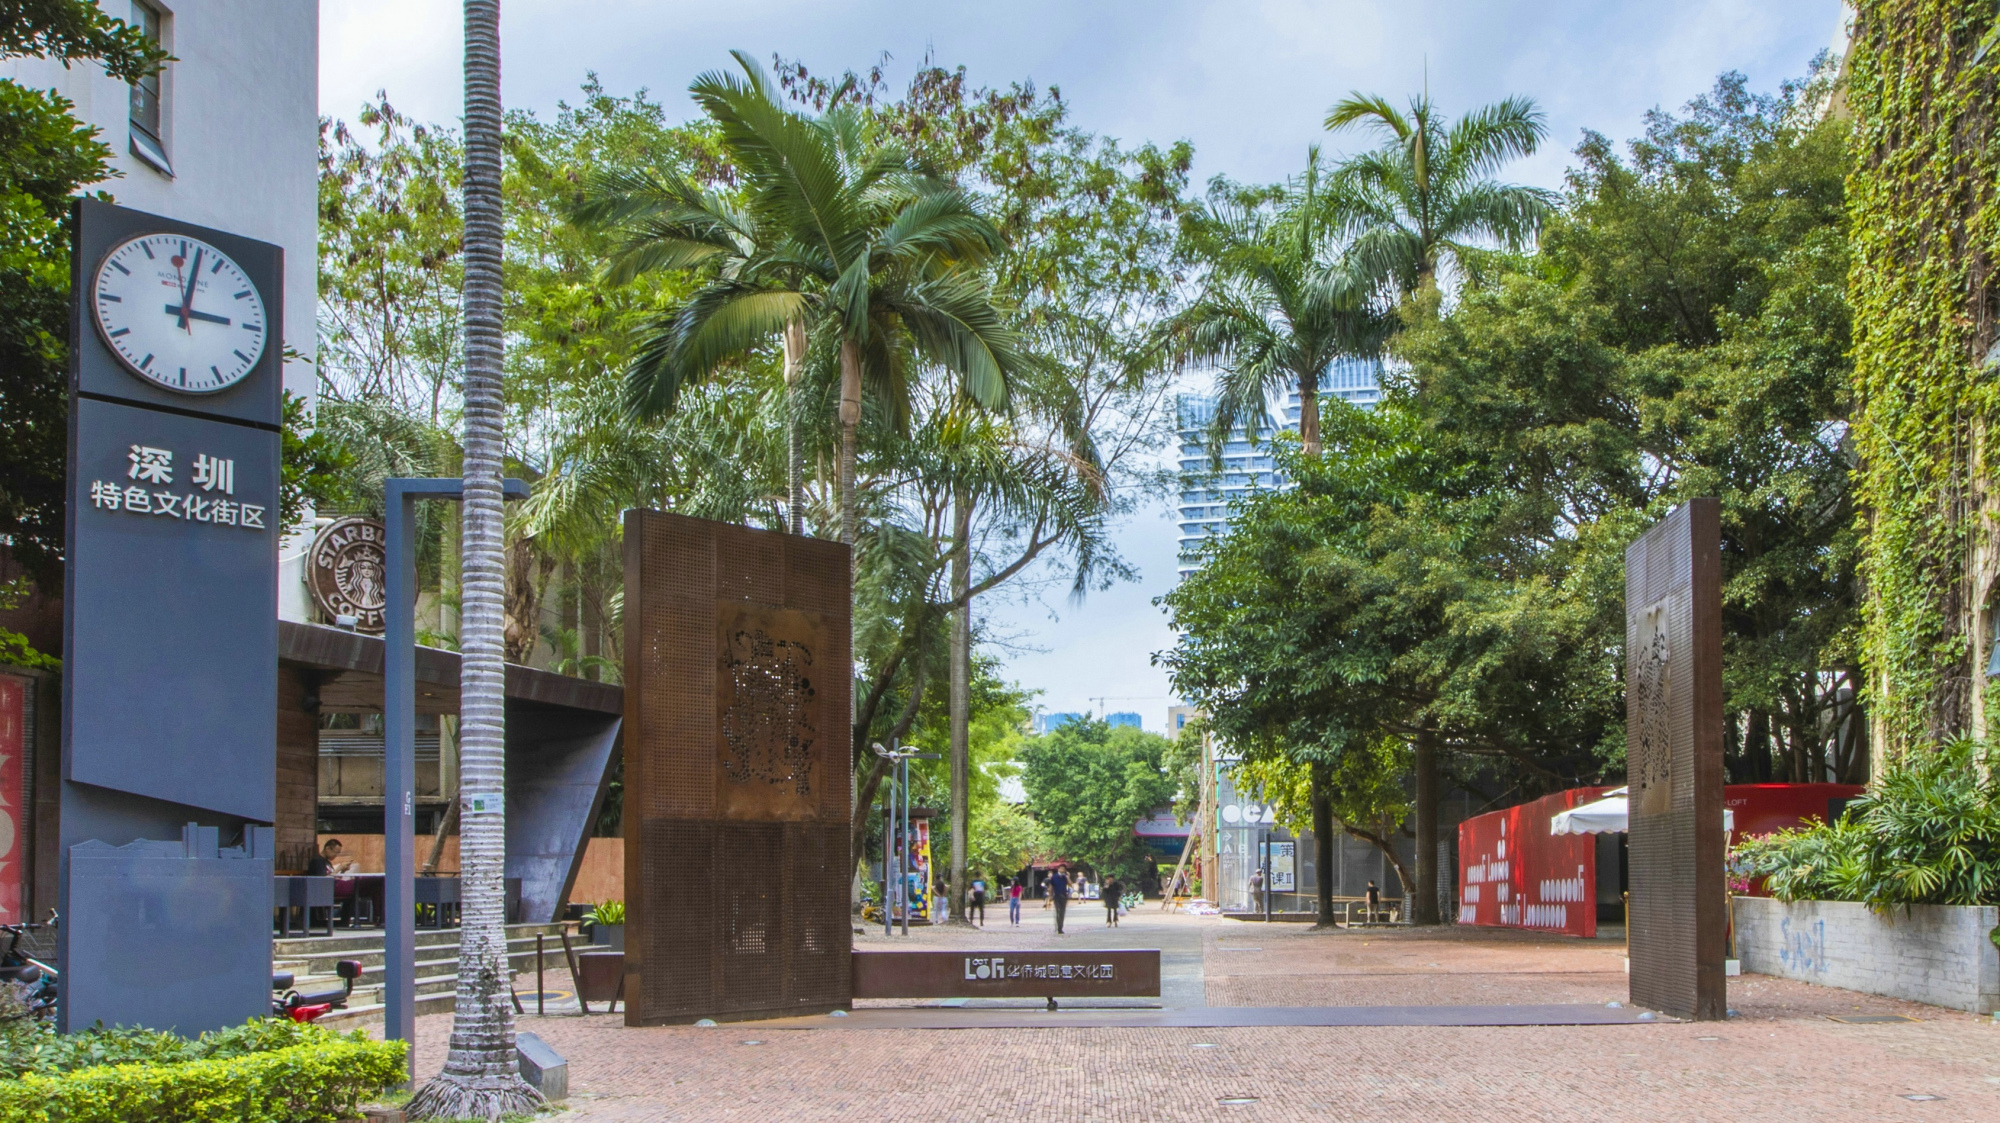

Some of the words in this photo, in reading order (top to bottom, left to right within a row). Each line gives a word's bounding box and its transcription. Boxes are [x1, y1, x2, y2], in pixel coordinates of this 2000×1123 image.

[157, 271, 209, 288] MONDNE
[127, 444, 234, 495] 深圳
[90, 480, 266, 529] 特色文化街区
[318, 525, 386, 570] STARBU
[328, 593, 386, 626] COFF
